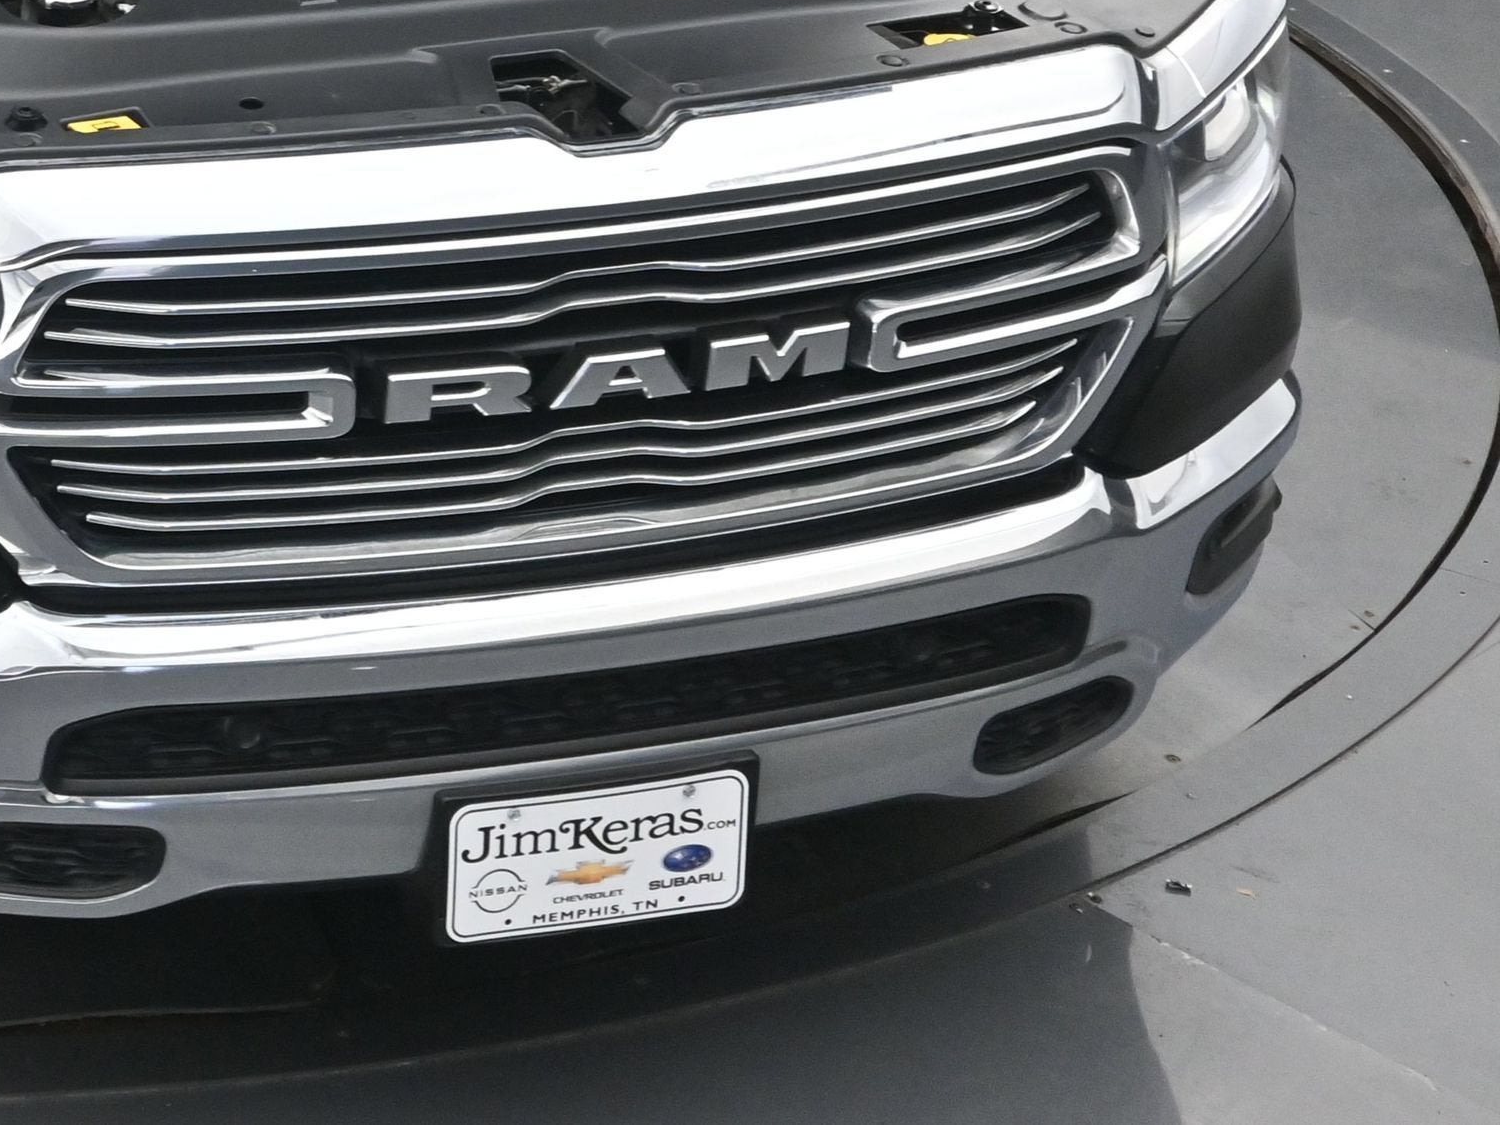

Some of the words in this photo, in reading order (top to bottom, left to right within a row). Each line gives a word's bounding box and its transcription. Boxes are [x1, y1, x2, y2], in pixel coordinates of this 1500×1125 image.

[385, 321, 850, 424] RAM
[649, 872, 723, 890] SUBARU
[469, 884, 528, 898] NISSAN
[553, 889, 624, 904] CHEVROLET
[532, 905, 625, 923] MEMPHIS,
[632, 899, 658, 911] TN
